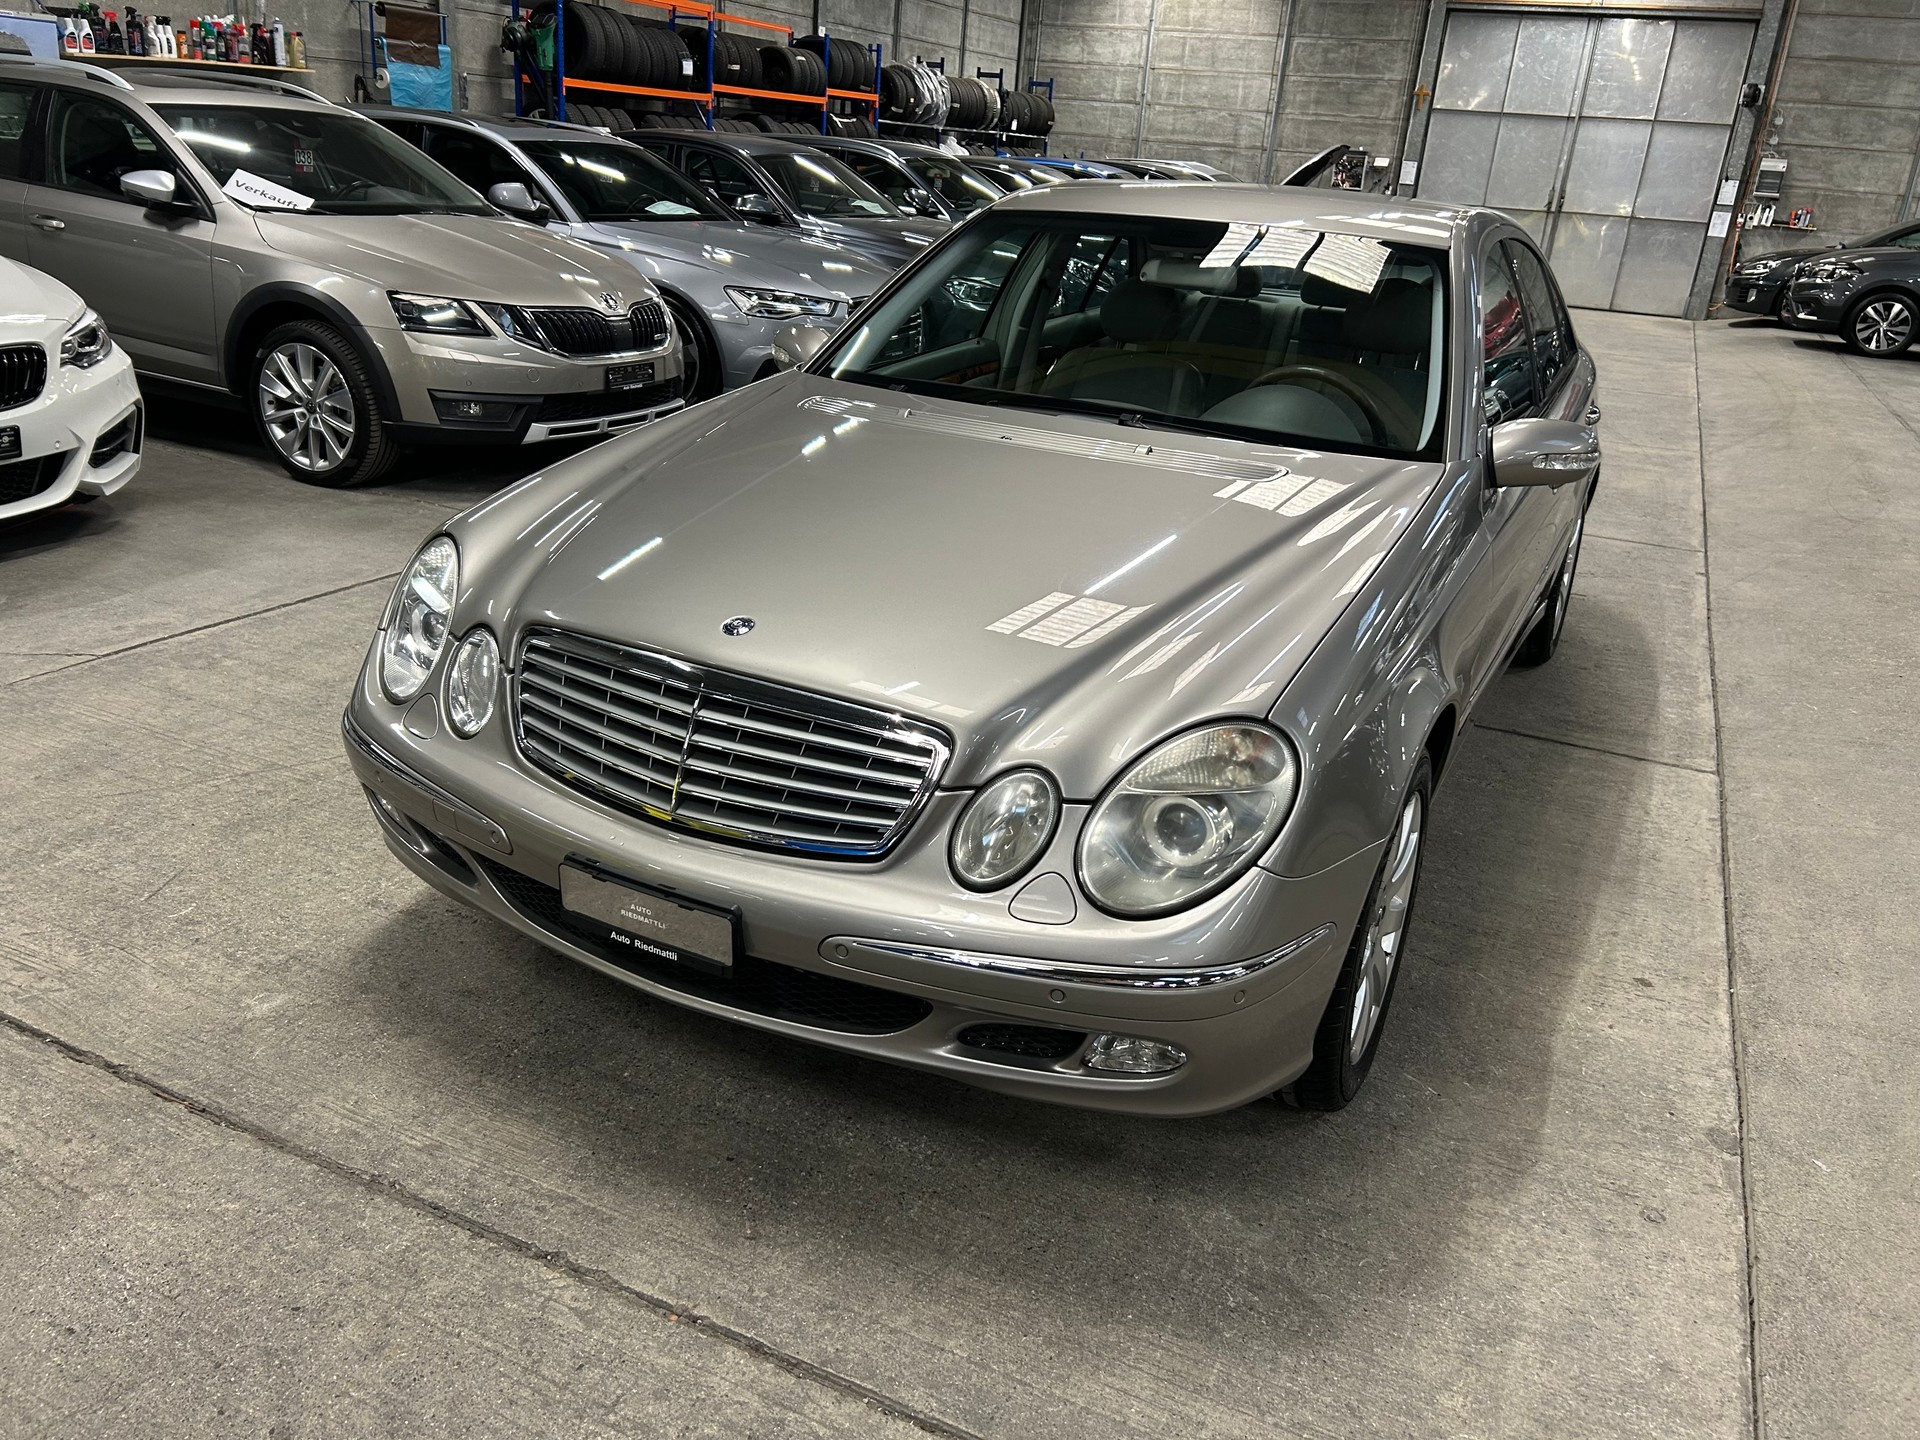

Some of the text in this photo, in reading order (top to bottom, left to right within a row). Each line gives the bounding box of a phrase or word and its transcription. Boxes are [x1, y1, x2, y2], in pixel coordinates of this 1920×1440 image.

[235, 179, 299, 209] Verkauft
[620, 909, 666, 929] RIEDMATTLI
[630, 904, 652, 915] AUTO
[610, 931, 678, 961] Auto Riedmattli
